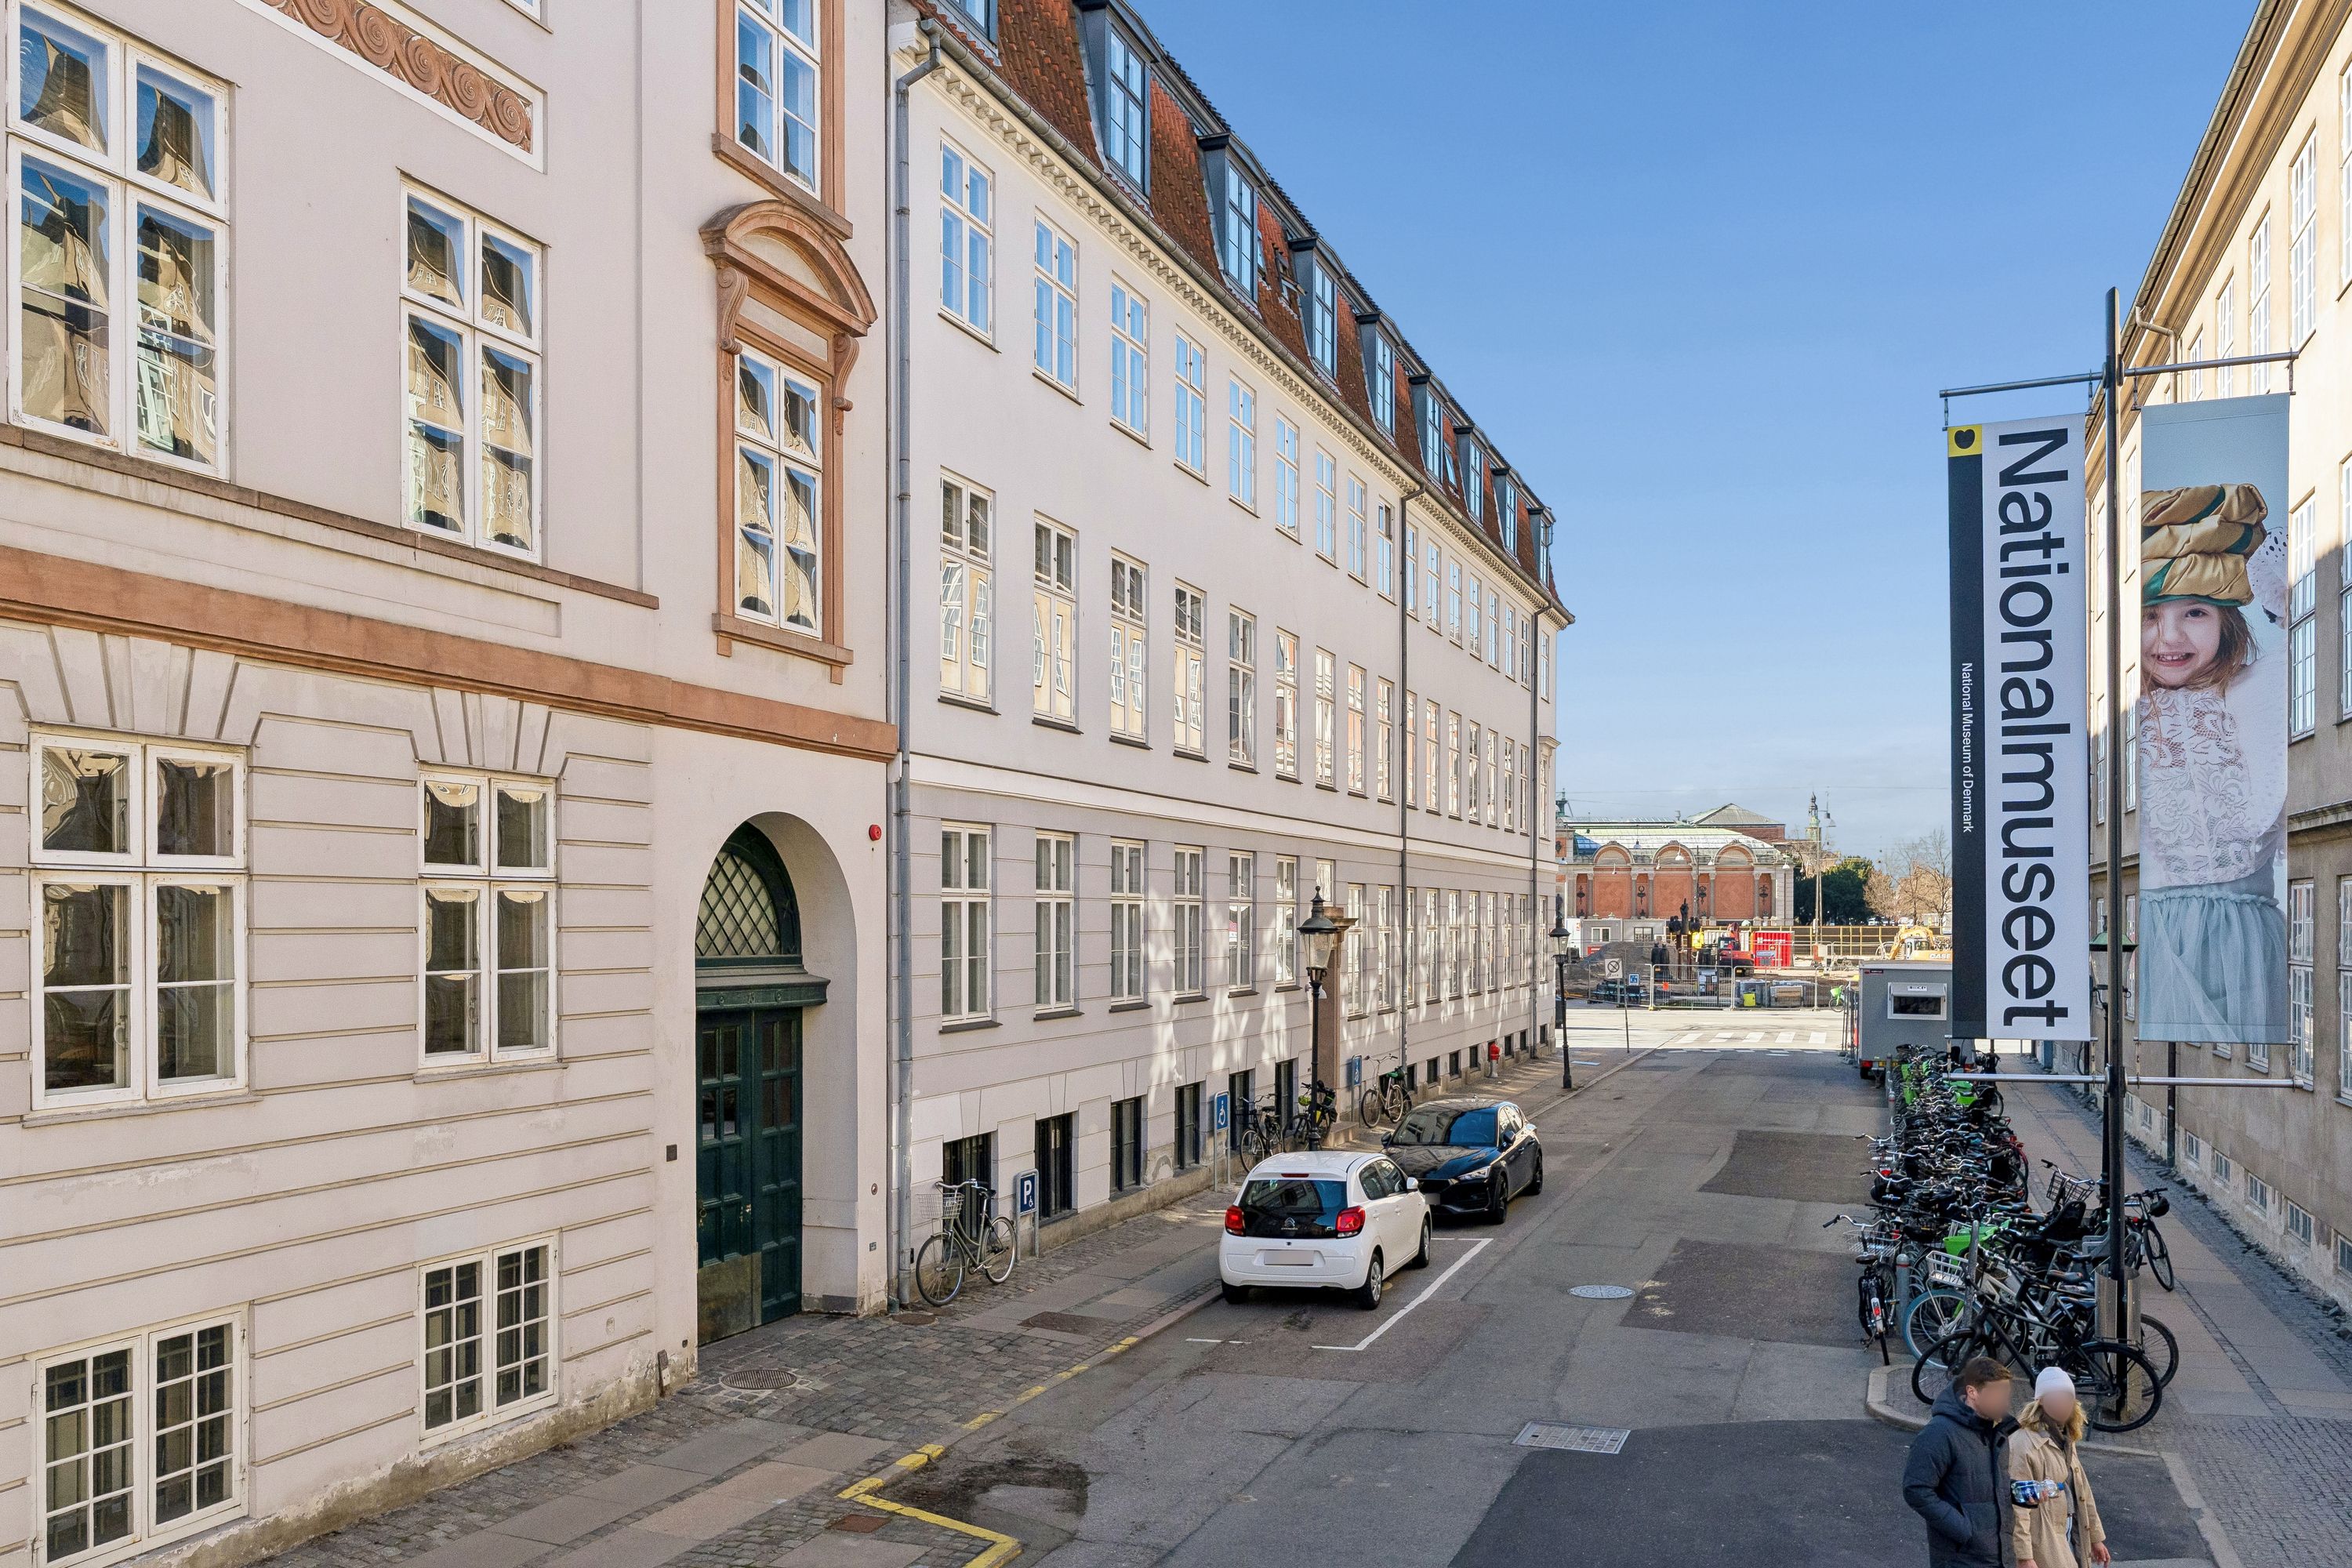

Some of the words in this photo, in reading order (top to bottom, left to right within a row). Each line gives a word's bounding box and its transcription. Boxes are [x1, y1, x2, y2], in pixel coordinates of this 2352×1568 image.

[1962, 662, 1973, 710] National
[1962, 713, 1973, 764] Museum
[1998, 427, 2071, 1028] Nationalmuseet
[1962, 766, 1974, 778] of
[1962, 780, 1974, 833] Denmark
[1023, 1179, 1033, 1205] P
